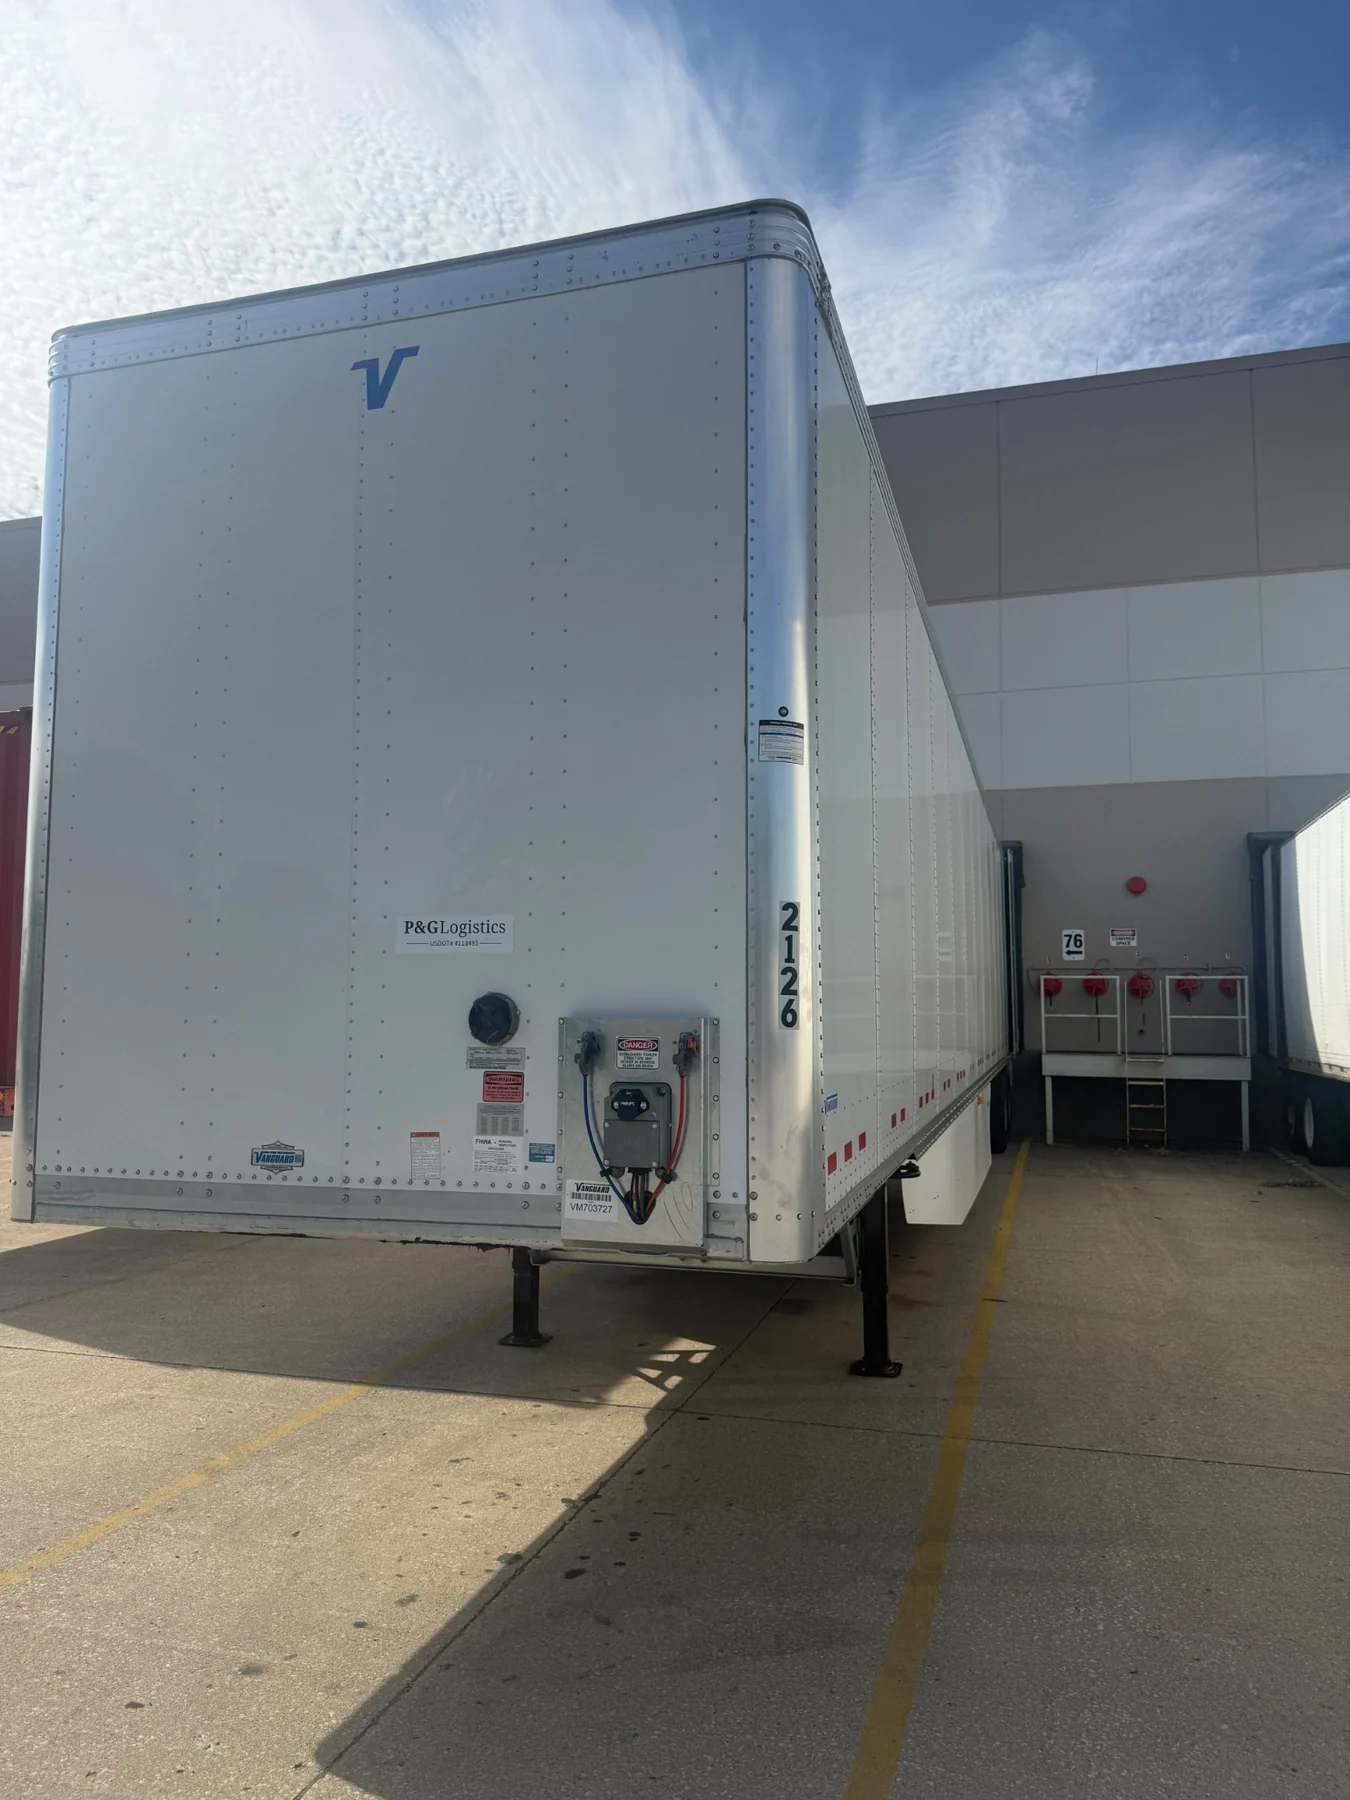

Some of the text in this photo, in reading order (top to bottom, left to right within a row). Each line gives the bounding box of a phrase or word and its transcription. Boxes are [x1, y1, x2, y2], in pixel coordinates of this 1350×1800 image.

[1063, 933, 1083, 949] 76
[780, 902, 799, 1028] 2126
[623, 1041, 653, 1049] DANGER
[254, 1151, 295, 1164] VANGUARD
[574, 1182, 610, 1194] VANGUARD
[569, 1202, 613, 1214] VM703727
